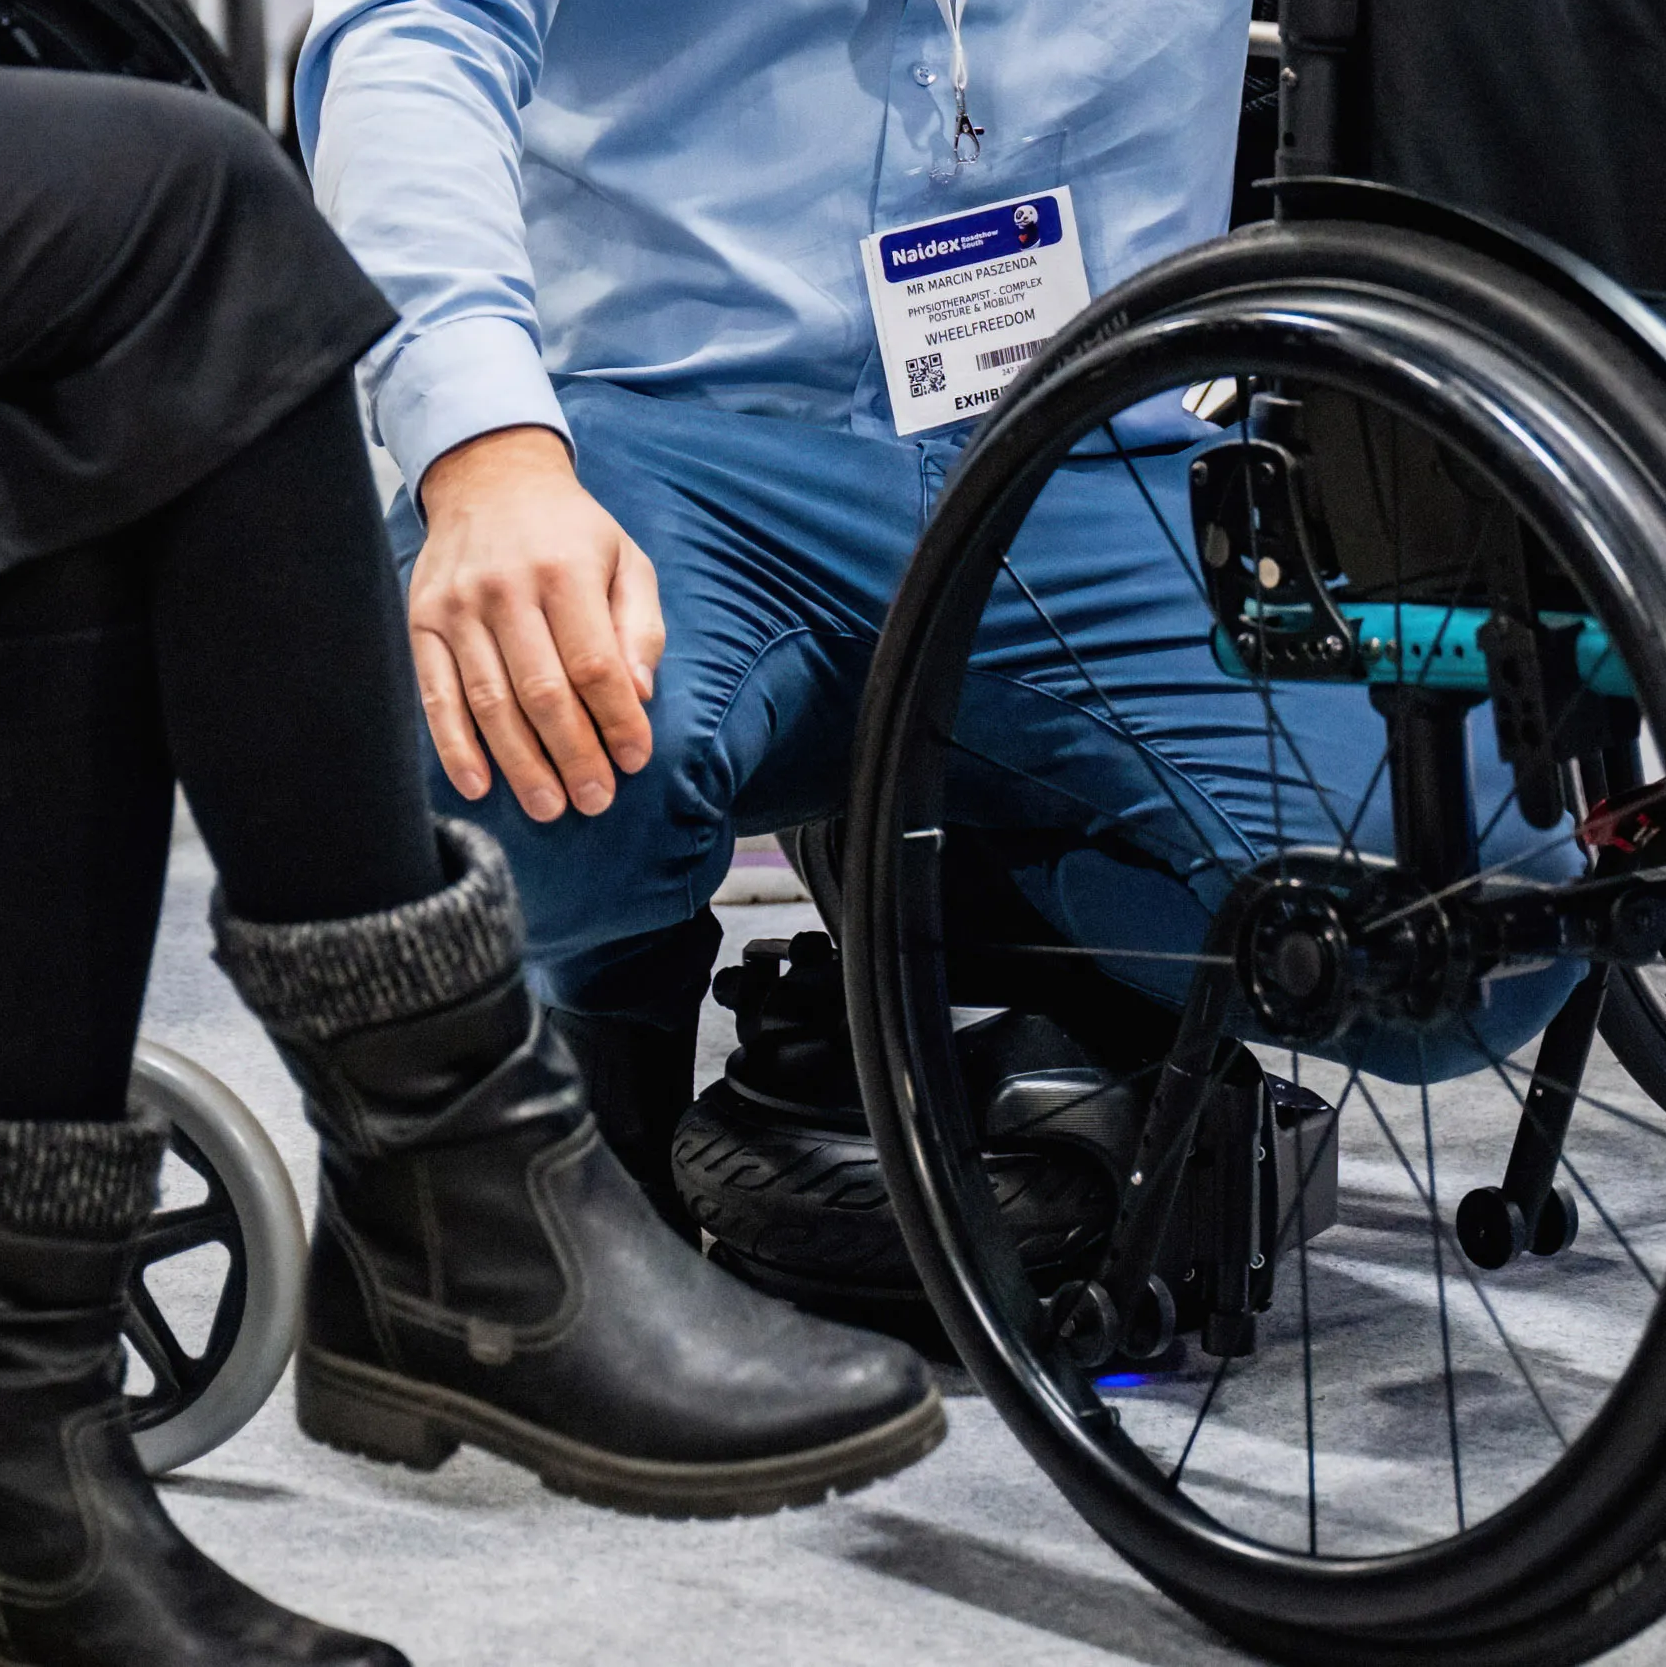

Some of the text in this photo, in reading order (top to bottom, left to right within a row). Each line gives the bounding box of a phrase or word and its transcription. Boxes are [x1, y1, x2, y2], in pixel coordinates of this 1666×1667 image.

[892, 237, 960, 266] Naidex
[907, 255, 1038, 296] MR MARCIN PASZENDA
[908, 289, 991, 318] PHYSIOTHERAPIST
[999, 277, 1043, 296] COMPLEX
[928, 292, 1026, 323] POSTURE & MOBILITY
[925, 308, 1036, 346] WHEELFREEDOM
